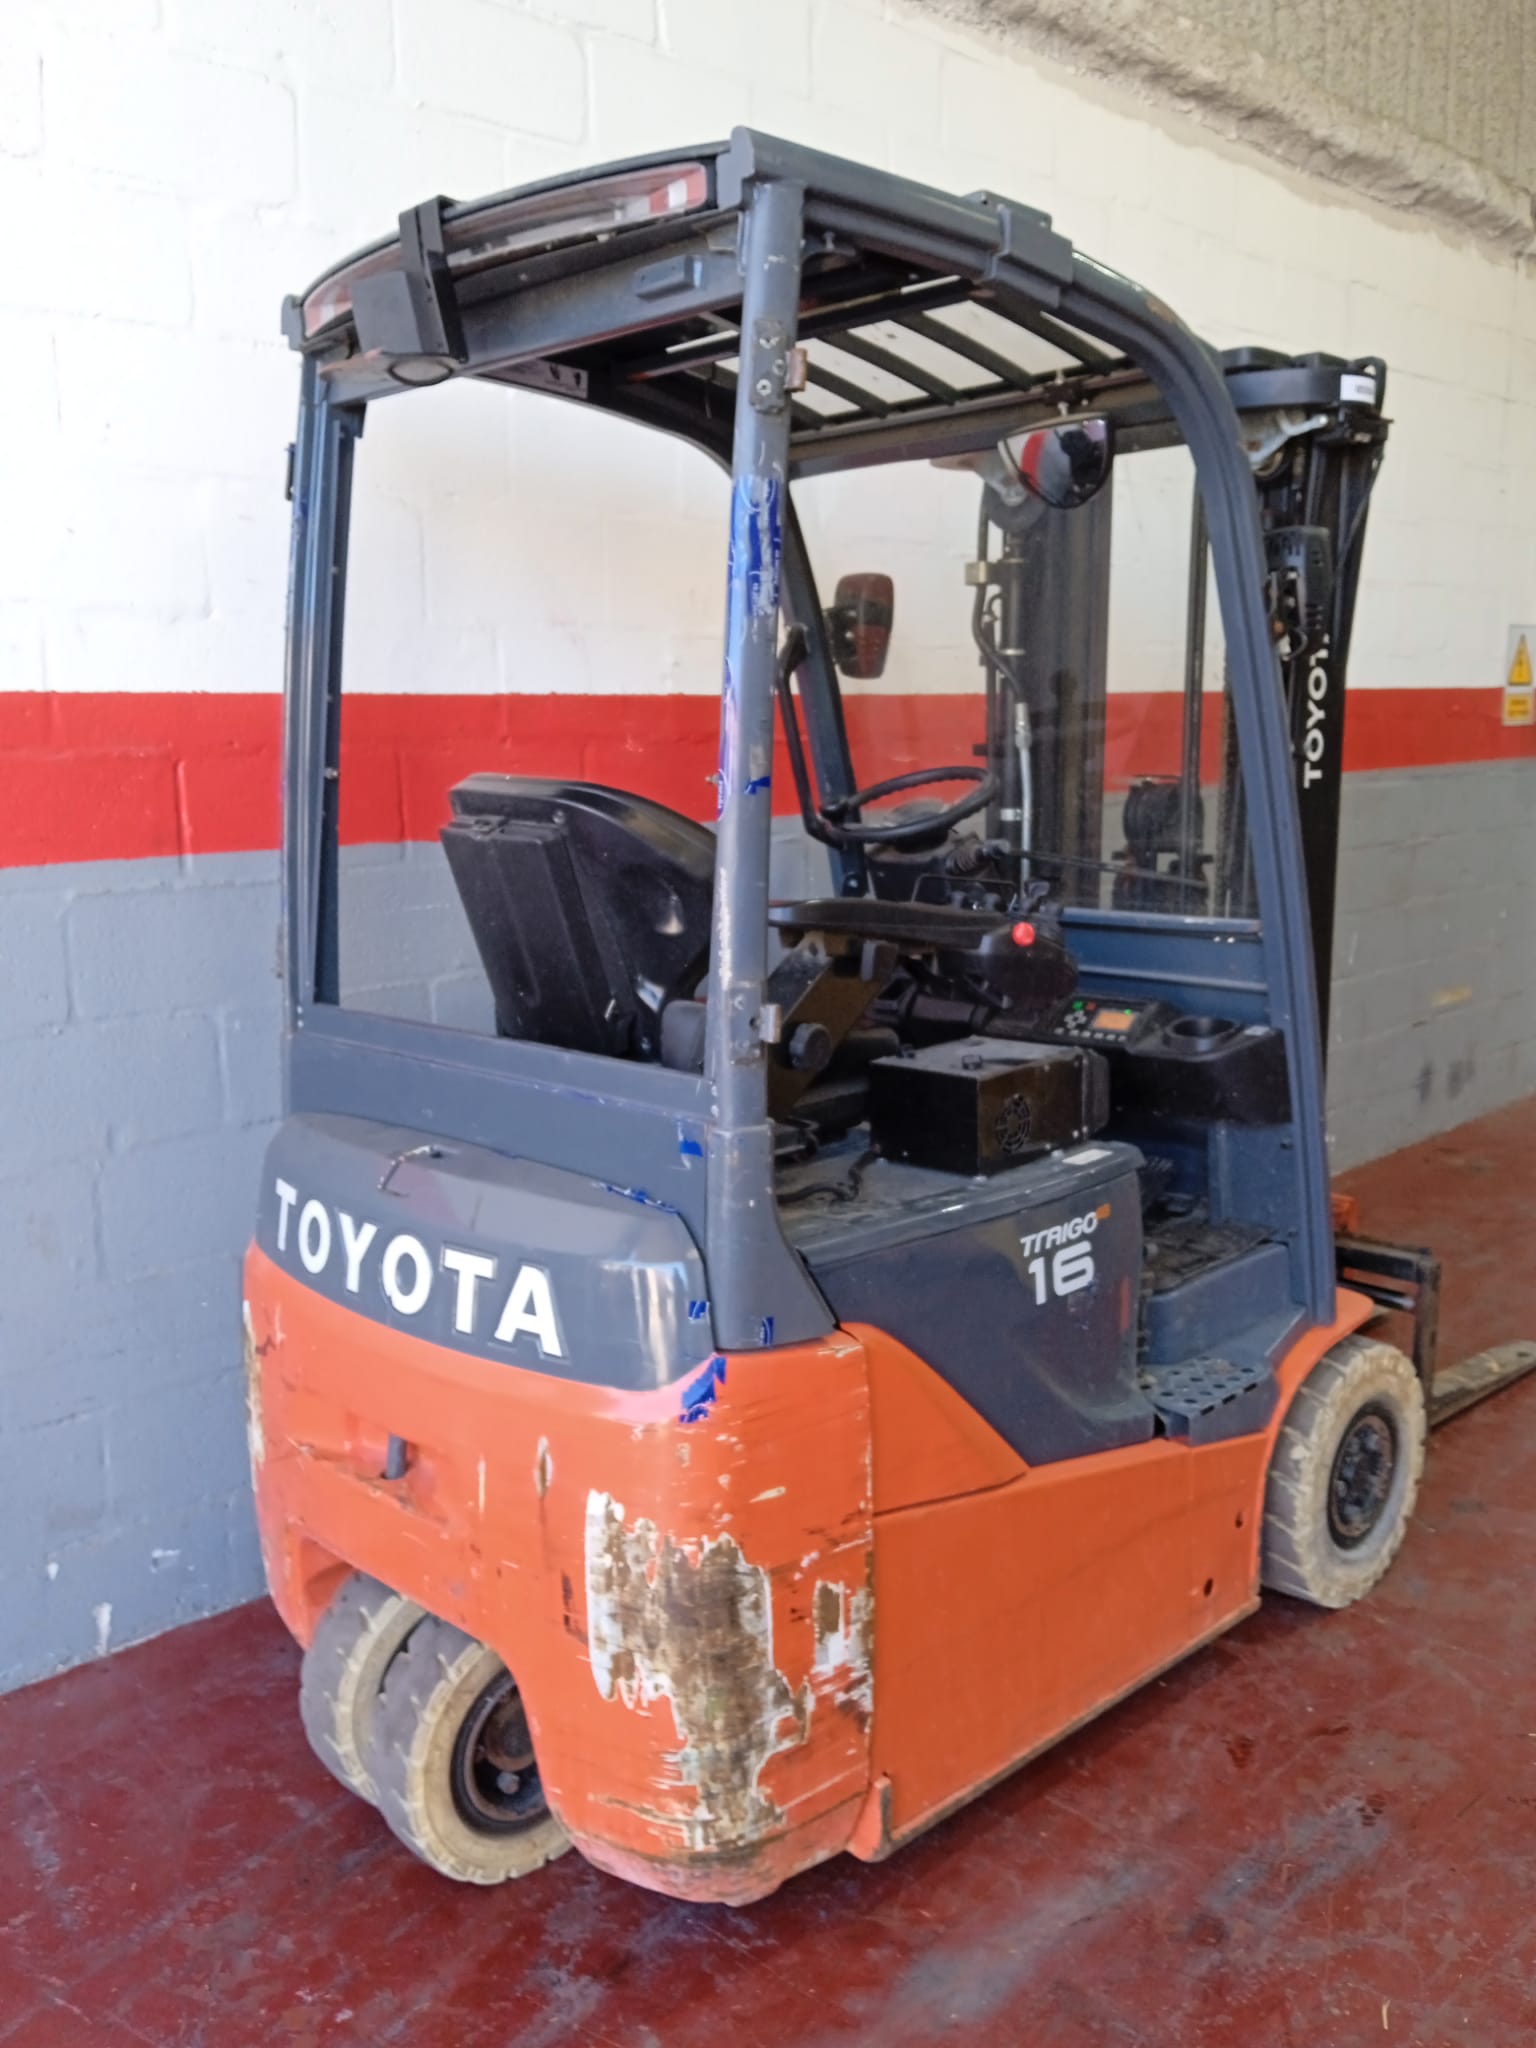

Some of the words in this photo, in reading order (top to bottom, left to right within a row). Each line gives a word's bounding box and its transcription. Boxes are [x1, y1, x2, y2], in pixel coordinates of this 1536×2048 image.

[1303, 633, 1330, 789] TOYOT
[276, 1178, 563, 1358] TOYOTA
[1028, 1240, 1095, 1305] 16
